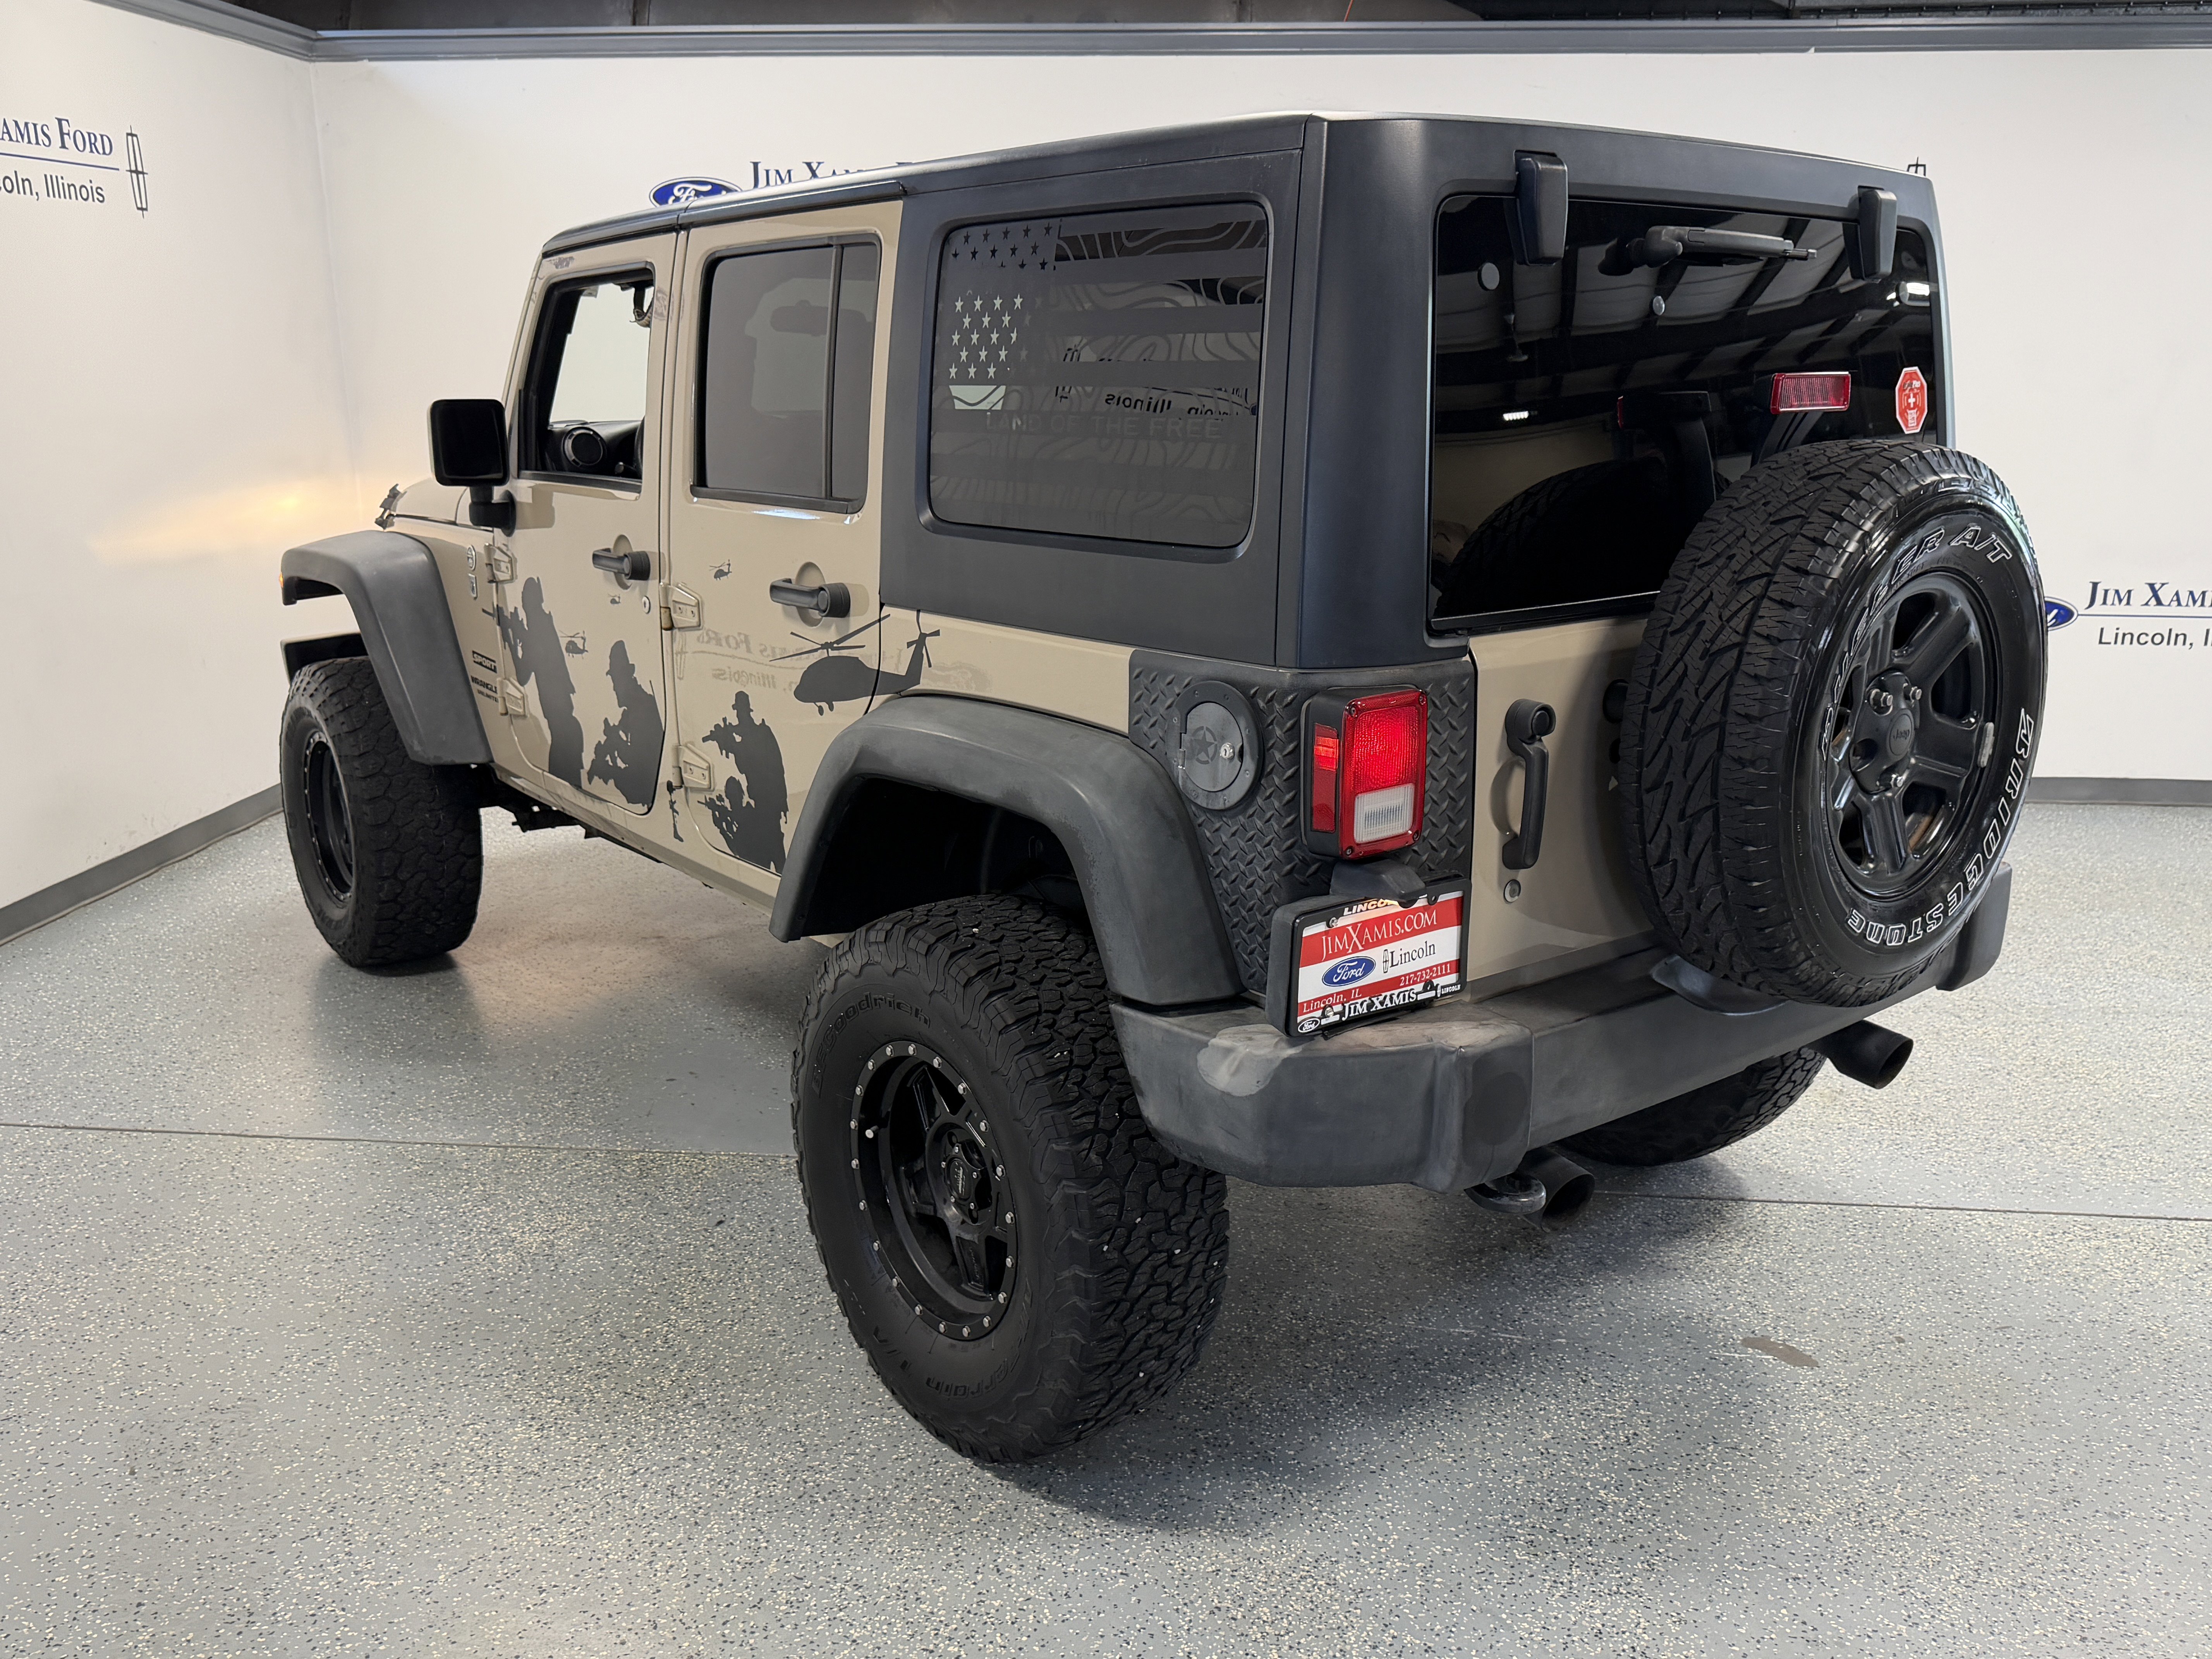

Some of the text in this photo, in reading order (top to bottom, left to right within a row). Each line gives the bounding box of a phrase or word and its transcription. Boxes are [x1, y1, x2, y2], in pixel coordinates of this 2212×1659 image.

[55, 117, 113, 156] FORD
[0, 170, 105, 203] oln, Illinois
[750, 161, 793, 189] JIM
[986, 411, 1221, 440] LAND OF THE FREE
[1948, 522, 2013, 564] A/T
[2085, 581, 2134, 610] JIM
[2098, 627, 2193, 650] Lincoln,
[473, 653, 495, 670] SPORT
[1848, 708, 2035, 946] BRIDGESTONE
[1343, 898, 1390, 916] LINCO
[1321, 909, 1437, 961] JIMXAMIS.COM
[1389, 940, 1436, 968] Lincoln
[1333, 961, 1365, 982] Ford
[1399, 963, 1451, 986] 217-732-2111
[1342, 990, 1417, 1021] JIM XAMIS
[1350, 988, 1362, 999] IL
[1302, 1021, 1316, 1031] Ford
